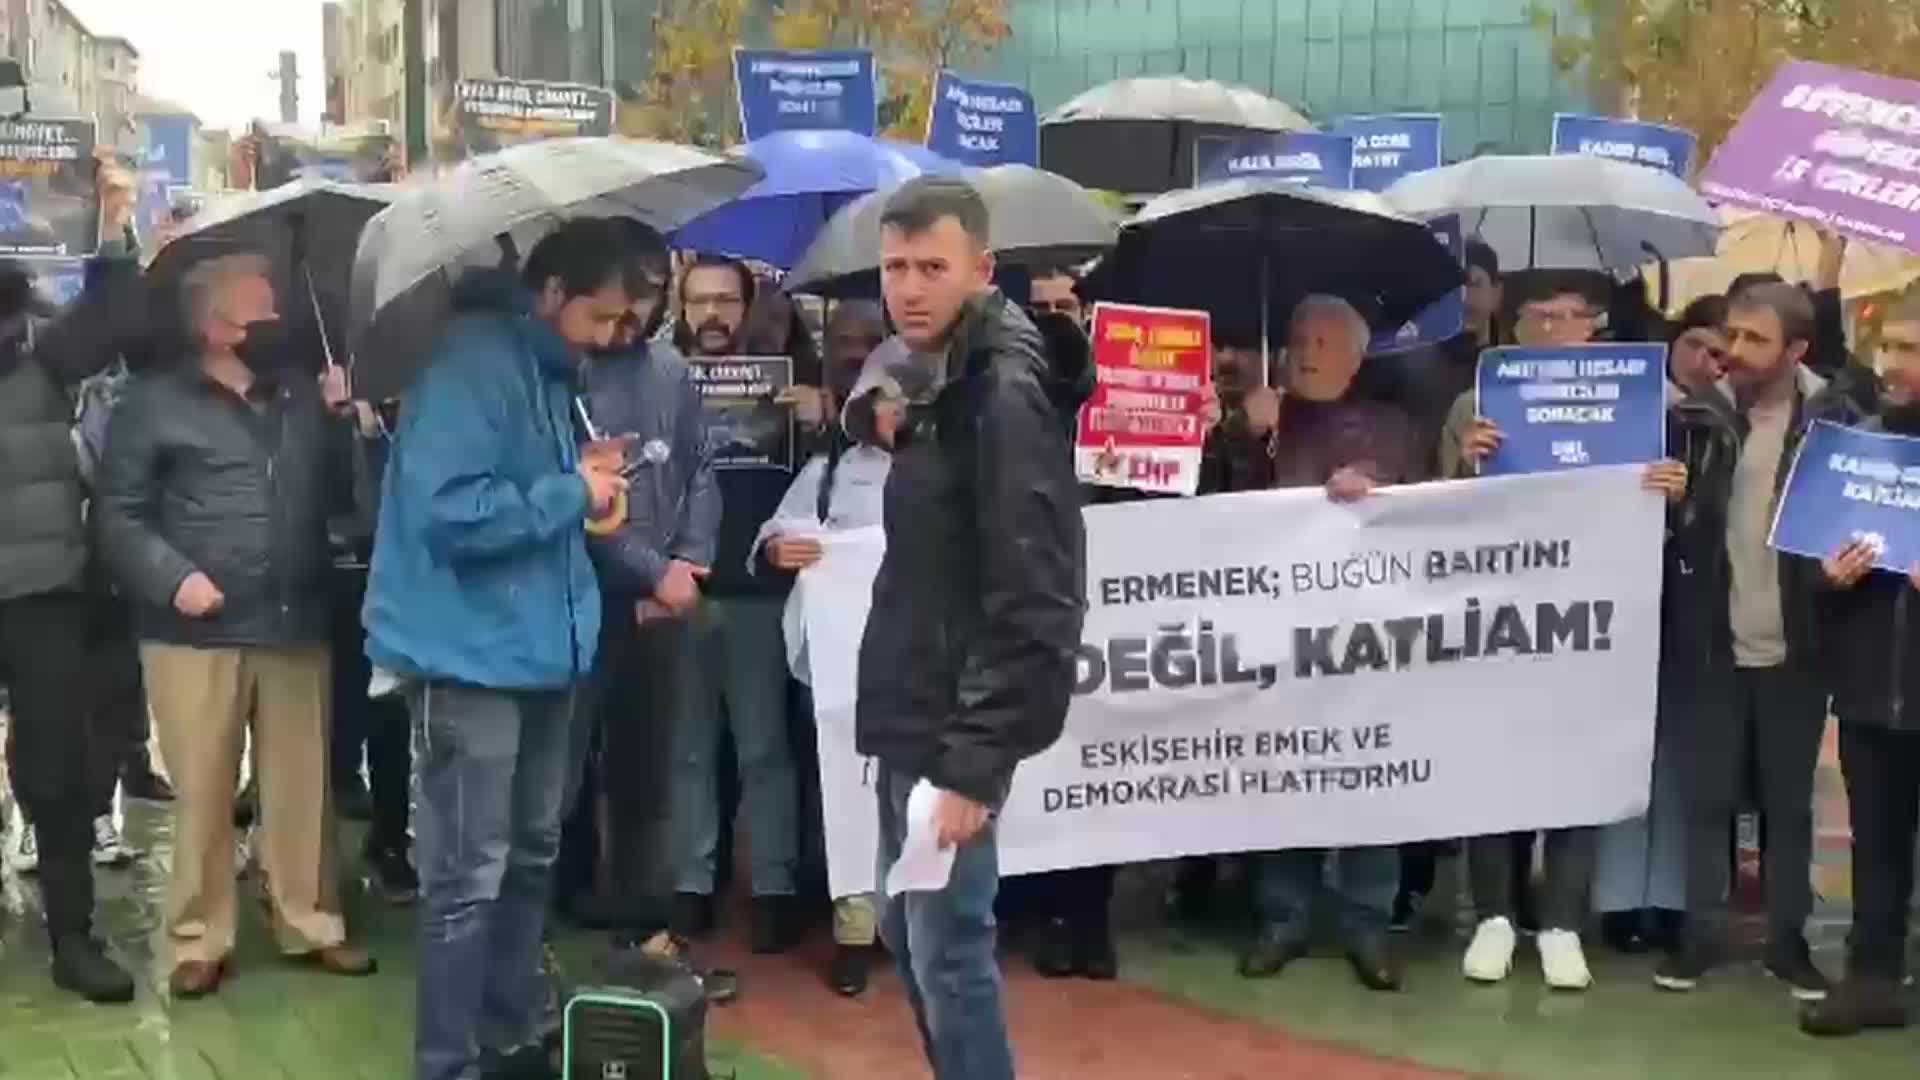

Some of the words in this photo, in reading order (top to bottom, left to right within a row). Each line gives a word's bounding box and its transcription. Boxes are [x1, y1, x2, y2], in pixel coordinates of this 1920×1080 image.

[1100, 563, 1280, 605] ERMENEK;
[1291, 550, 1412, 592] BUĞÜN
[1424, 539, 1571, 582] BARTIN!
[1070, 618, 1277, 695] DEĞİL,
[1294, 597, 1615, 678] KATLİAM!
[1080, 728, 1245, 769] ESKİŞEHİR
[1352, 723, 1392, 750] VE
[1043, 771, 1231, 812] DEMOKRASİ
[1240, 758, 1432, 795] PLATFORMU
